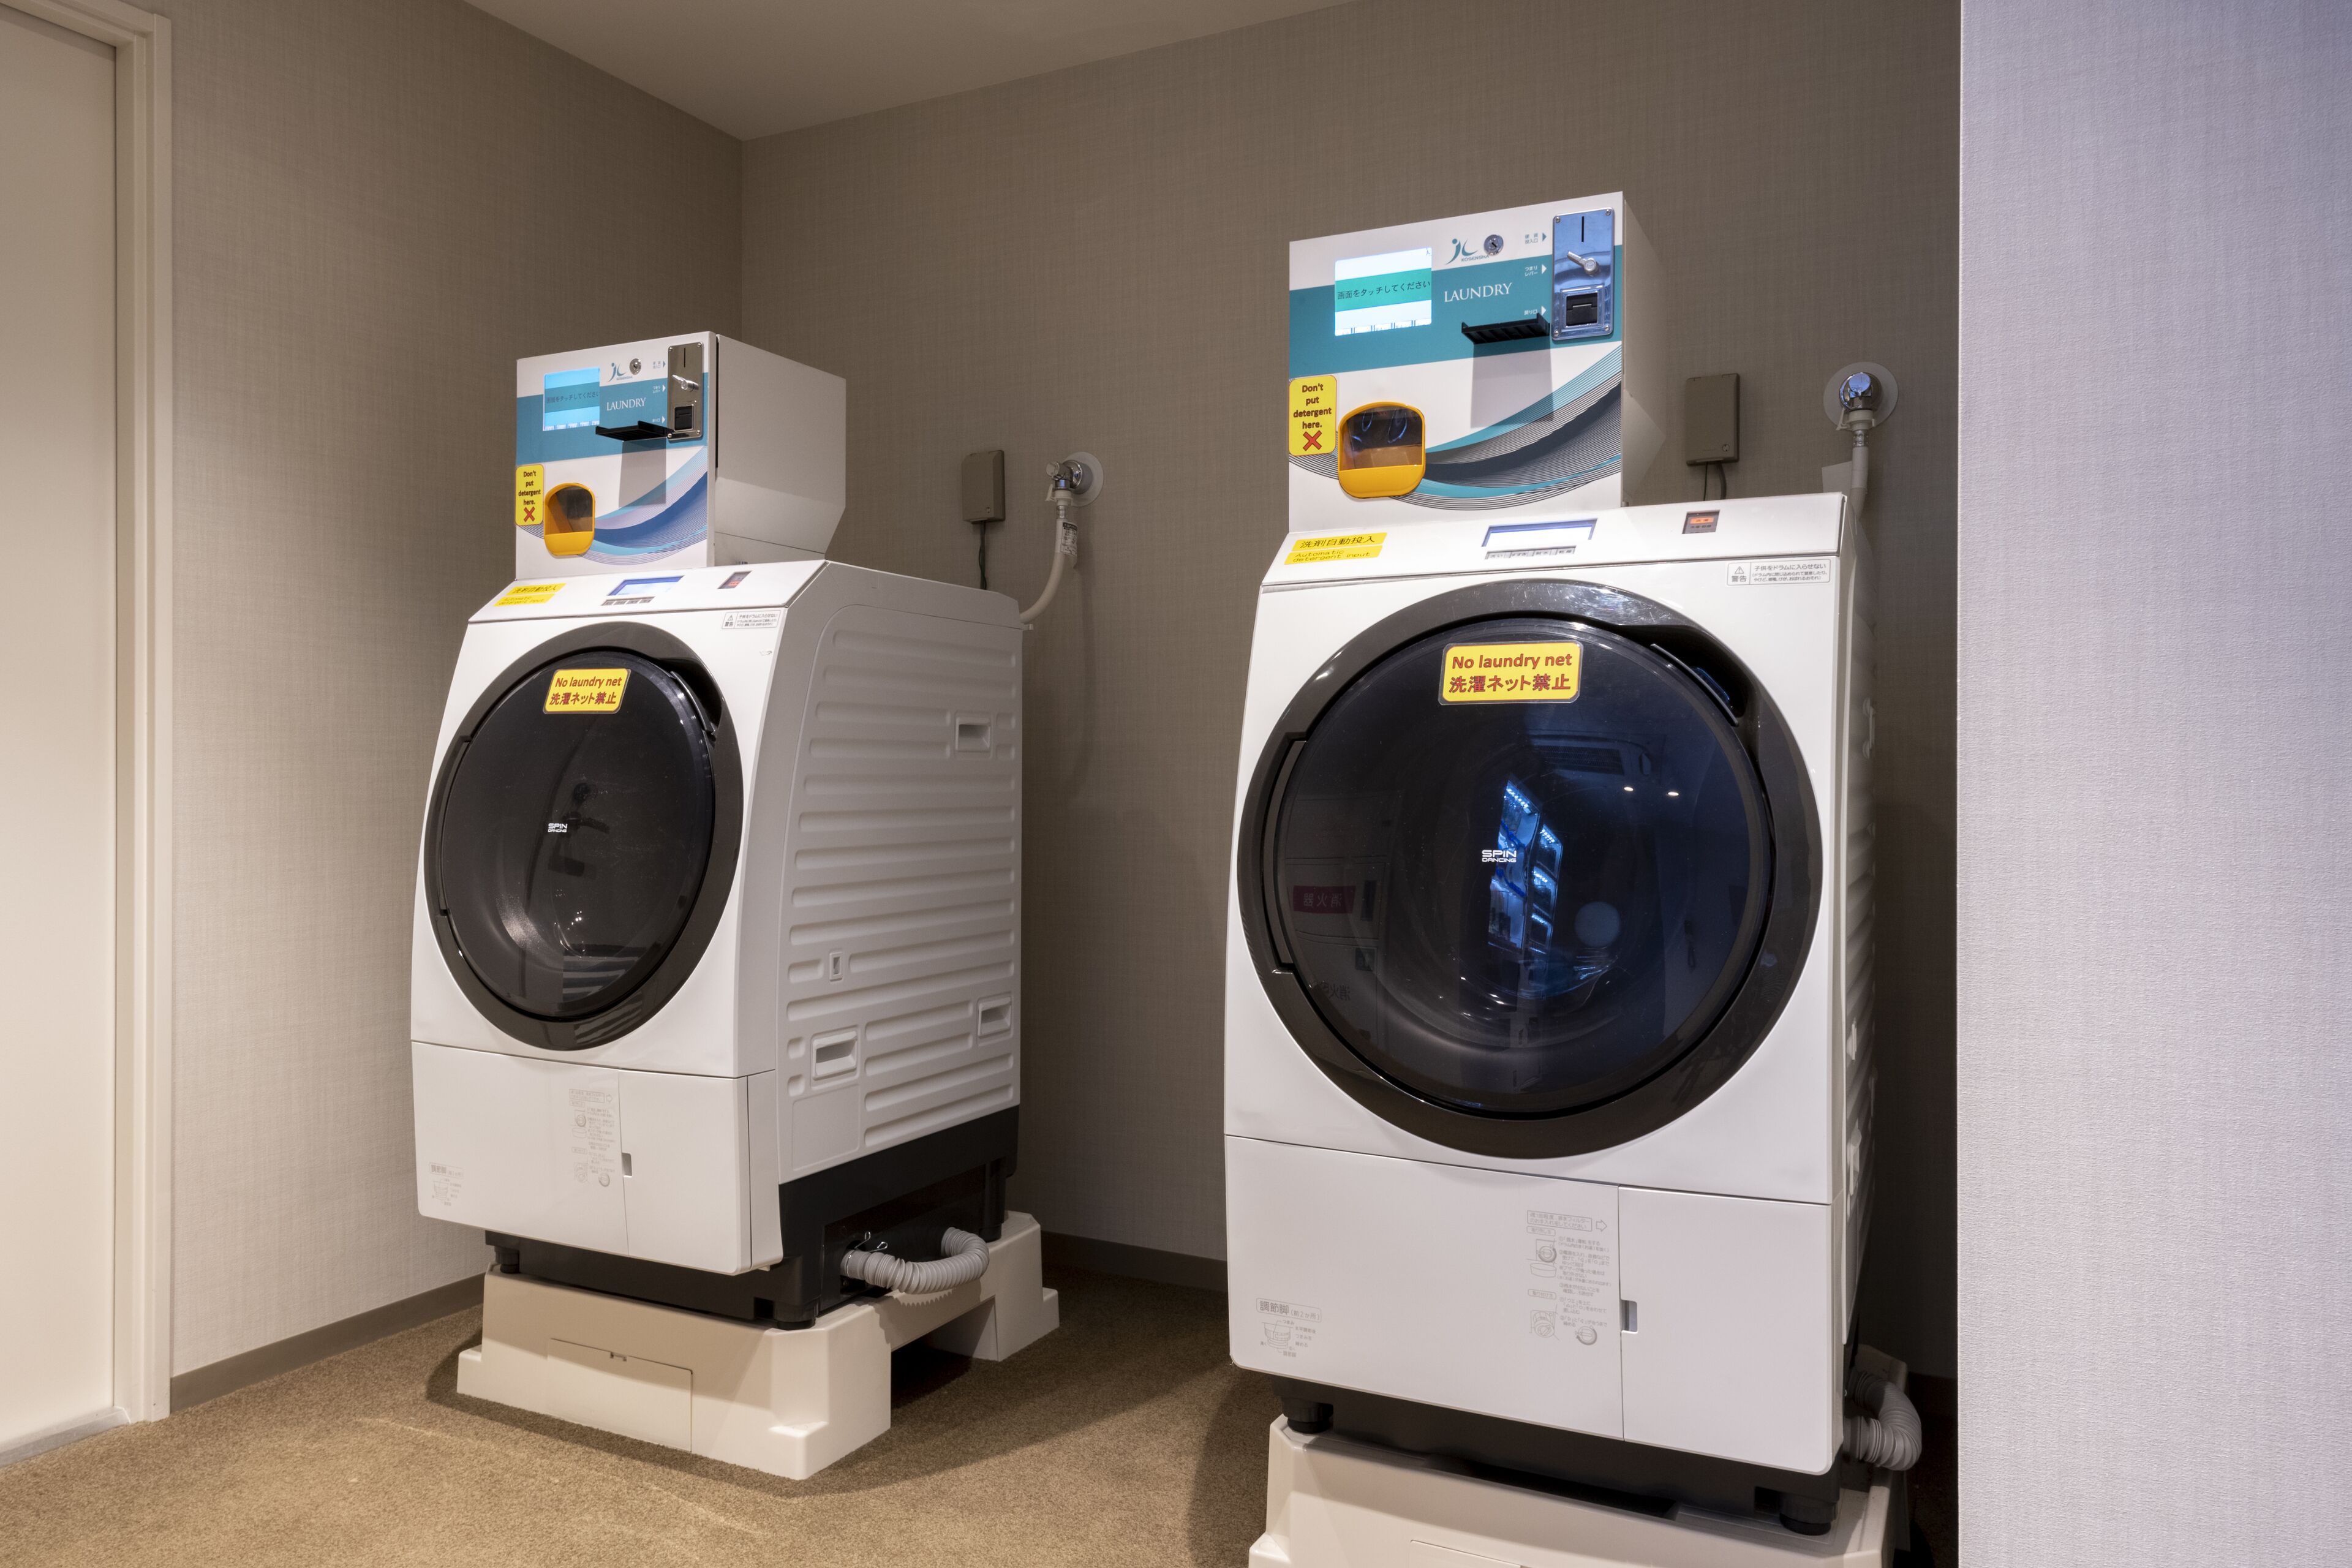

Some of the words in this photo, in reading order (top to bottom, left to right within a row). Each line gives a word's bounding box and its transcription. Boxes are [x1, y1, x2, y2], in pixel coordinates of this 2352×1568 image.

[1337, 281, 1431, 300] 画面をタッチしてください
[1444, 282, 1513, 303] LAUNDRY
[1302, 383, 1324, 393] Don't
[606, 398, 646, 411] LAUNDRY
[1306, 396, 1319, 406] put
[1293, 407, 1332, 417] detergent
[1299, 535, 1376, 549] 洗剤自動投入
[1452, 656, 1474, 669] No
[1479, 654, 1540, 669] laundry
[1545, 654, 1572, 666] net
[555, 677, 568, 687] No
[569, 676, 605, 688] laundry
[605, 677, 622, 687] net
[1449, 673, 1571, 693] 洗濯ネット禁止
[549, 692, 617, 705] 洗濯ネット禁止
[1260, 1300, 1289, 1315] 調節脚
